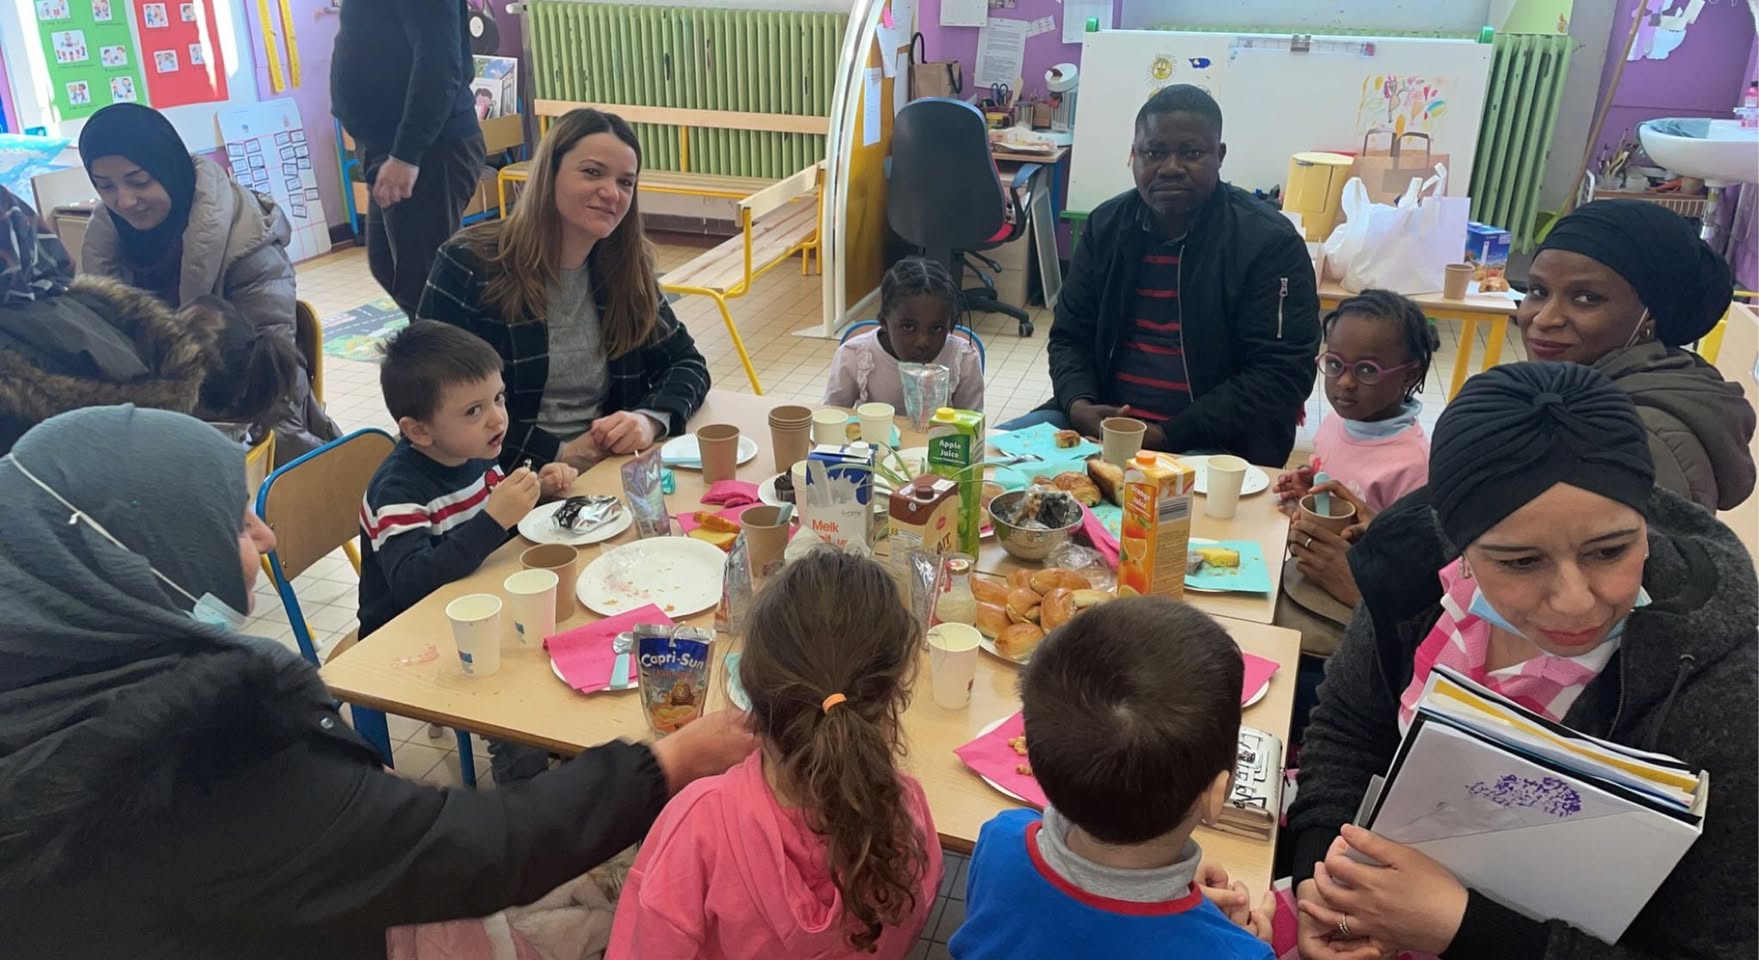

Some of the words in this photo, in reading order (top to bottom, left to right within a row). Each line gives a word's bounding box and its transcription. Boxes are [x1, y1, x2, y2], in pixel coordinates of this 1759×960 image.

[939, 440, 961, 450] Apple
[940, 449, 960, 458] Juice
[812, 519, 839, 533] Melk
[641, 651, 705, 669] Capri-Sun
